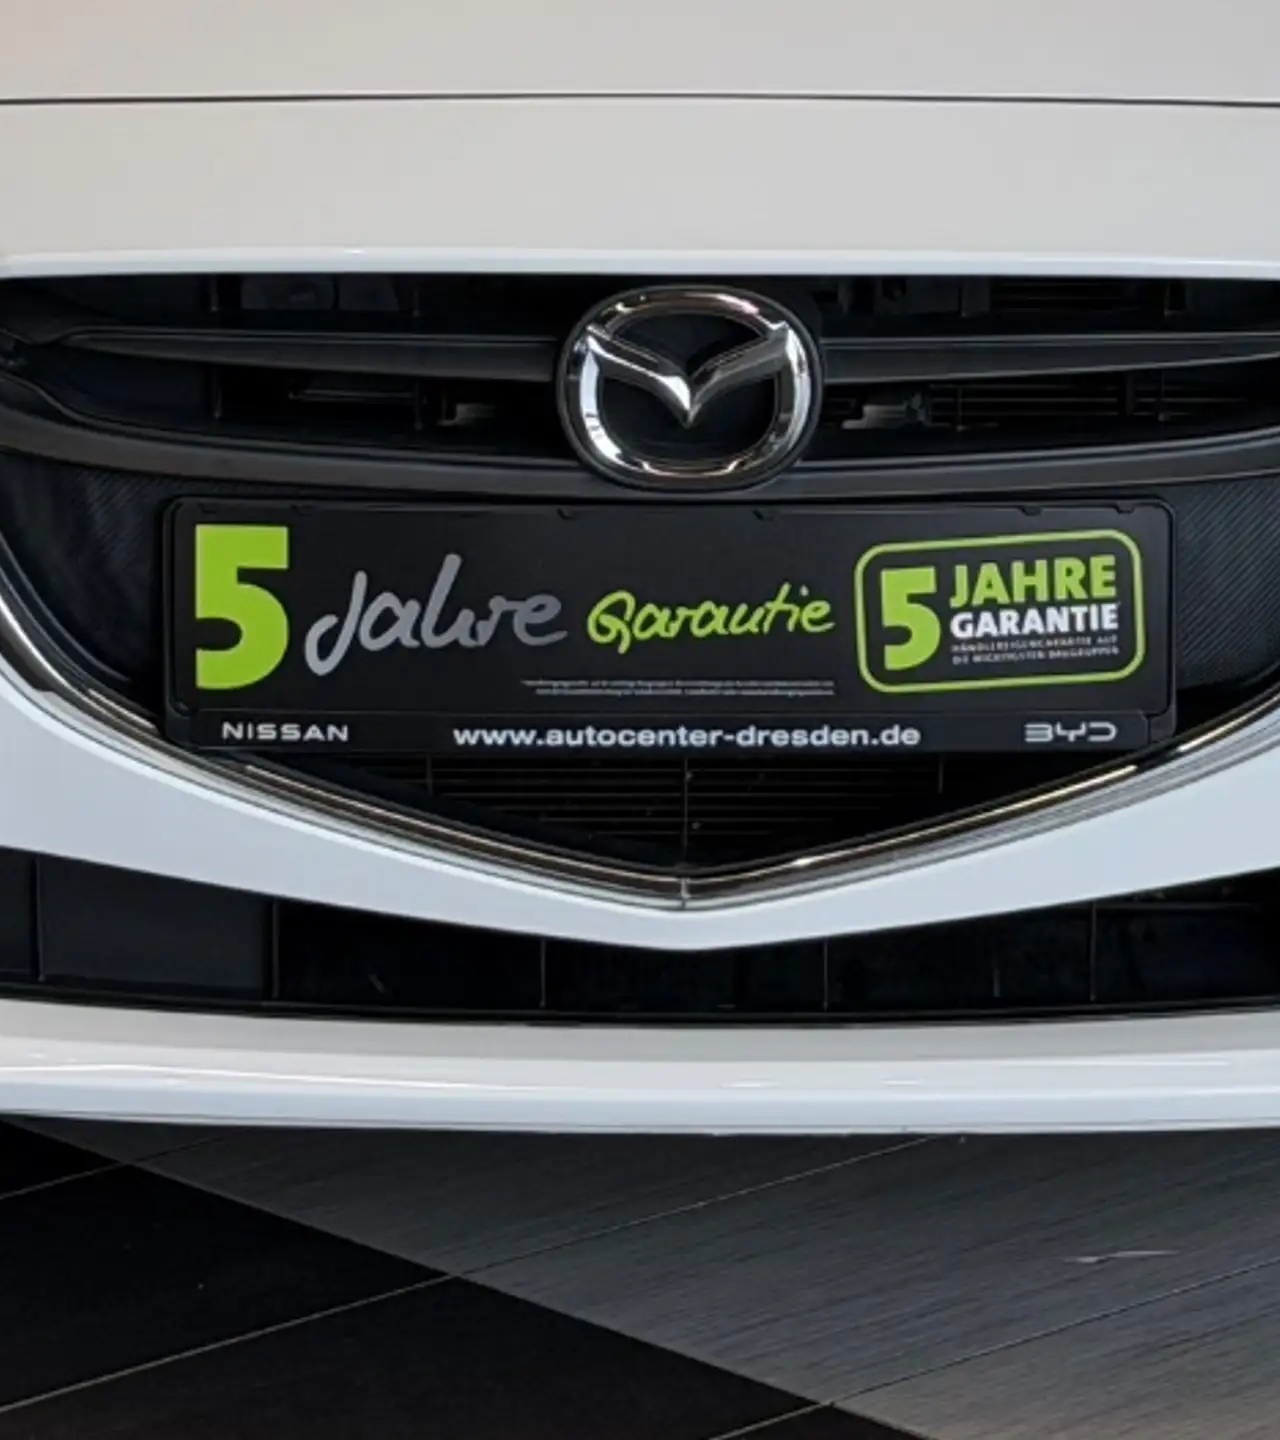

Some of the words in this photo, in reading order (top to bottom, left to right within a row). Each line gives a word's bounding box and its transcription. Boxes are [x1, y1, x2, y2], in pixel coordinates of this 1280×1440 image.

[195, 523, 290, 690] 5
[304, 553, 568, 677] Jahre
[587, 581, 836, 654] Garantie
[880, 565, 941, 671] 5
[949, 554, 1117, 609] JAHRE
[949, 602, 1120, 639] GARANTIE
[221, 721, 350, 742] NISSAN
[453, 725, 922, 749] www.autocenter-dresden.de
[1023, 722, 1118, 744] BYD
